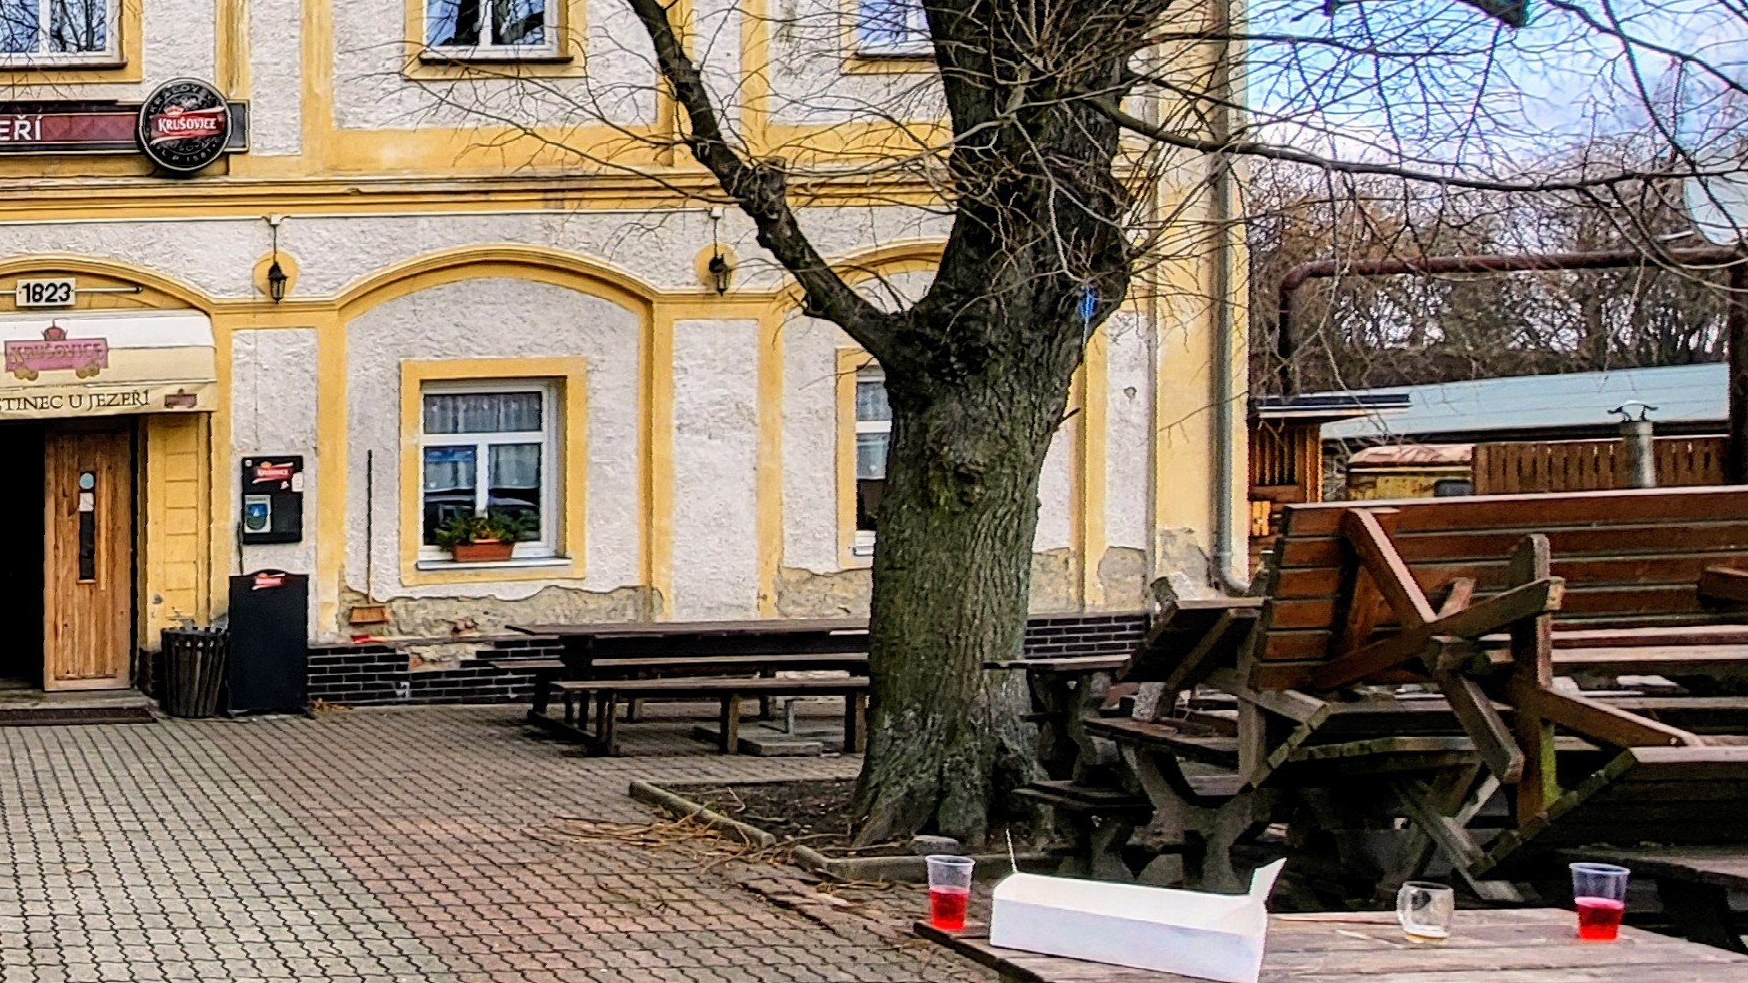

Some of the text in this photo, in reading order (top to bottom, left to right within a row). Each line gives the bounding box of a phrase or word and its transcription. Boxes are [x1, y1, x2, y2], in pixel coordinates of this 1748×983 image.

[158, 116, 217, 133] KRUŠOVICE
[21, 282, 72, 304] 1823
[68, 393, 83, 409] U
[86, 389, 150, 412] JEZEŘÍ
